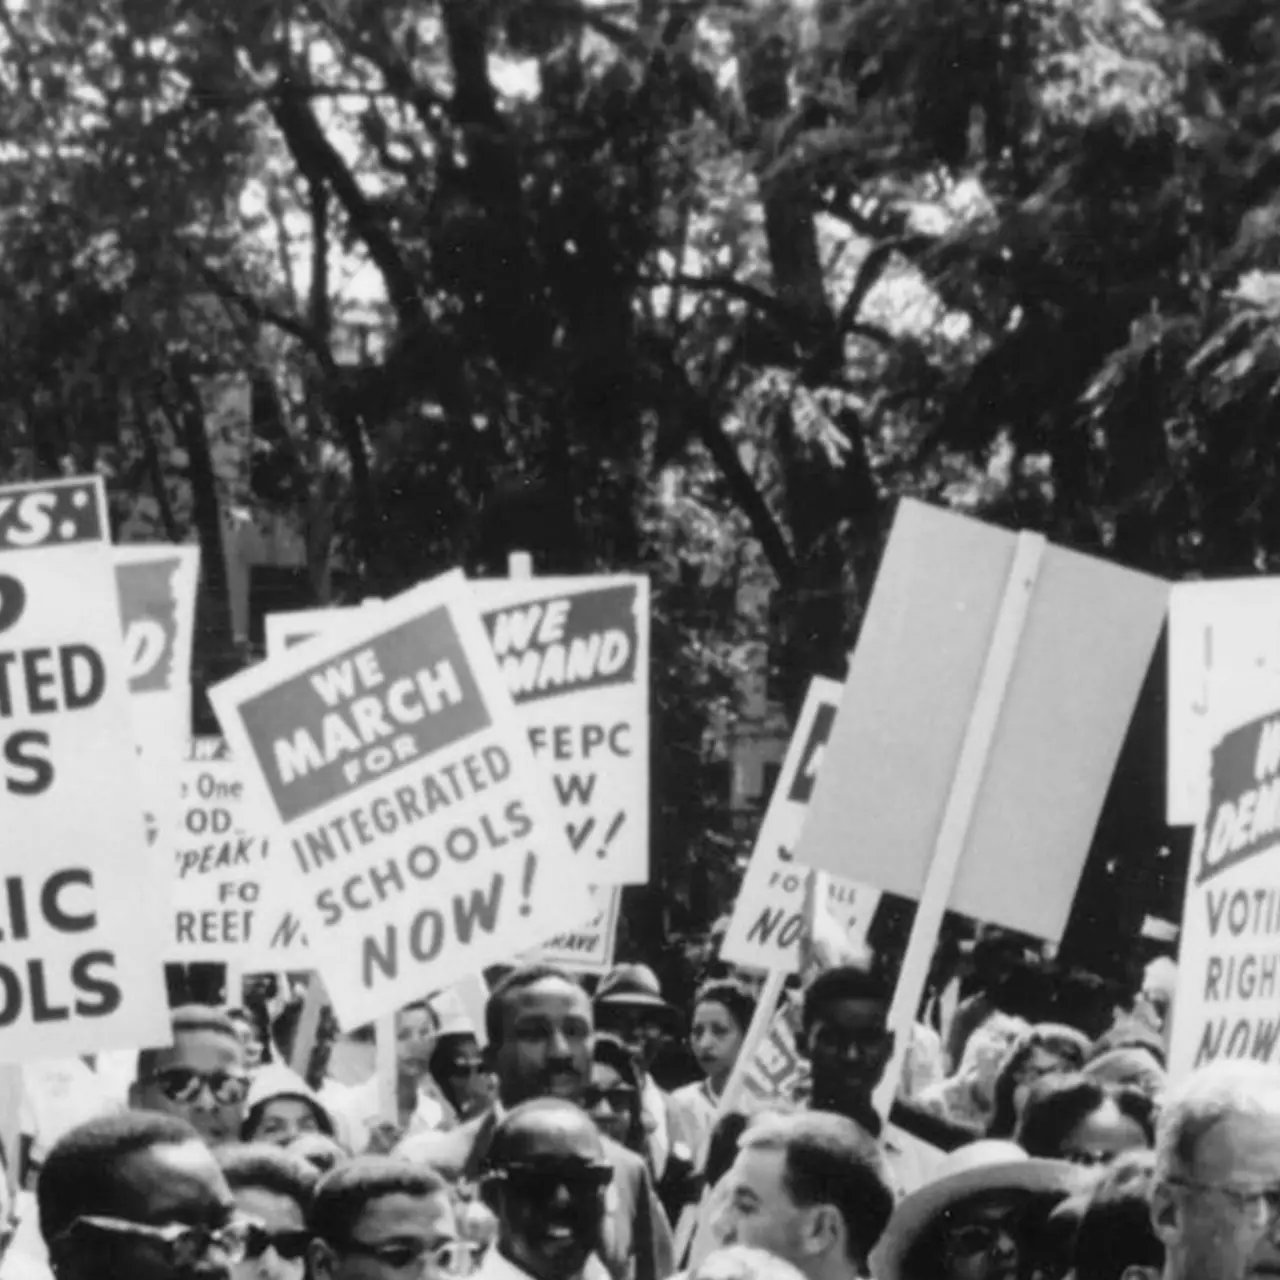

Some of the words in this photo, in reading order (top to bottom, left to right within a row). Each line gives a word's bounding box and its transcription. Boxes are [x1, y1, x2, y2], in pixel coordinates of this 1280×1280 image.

[492, 600, 571, 655] WE
[310, 648, 385, 707] WE
[270, 660, 463, 785] MARCH
[527, 721, 632, 761] FEPC
[343, 736, 420, 785] FOR
[292, 745, 511, 875] INTEGRATED
[175, 837, 255, 879] PEAK
[316, 801, 533, 925] SCHOOLS
[362, 852, 537, 989] NOW!
